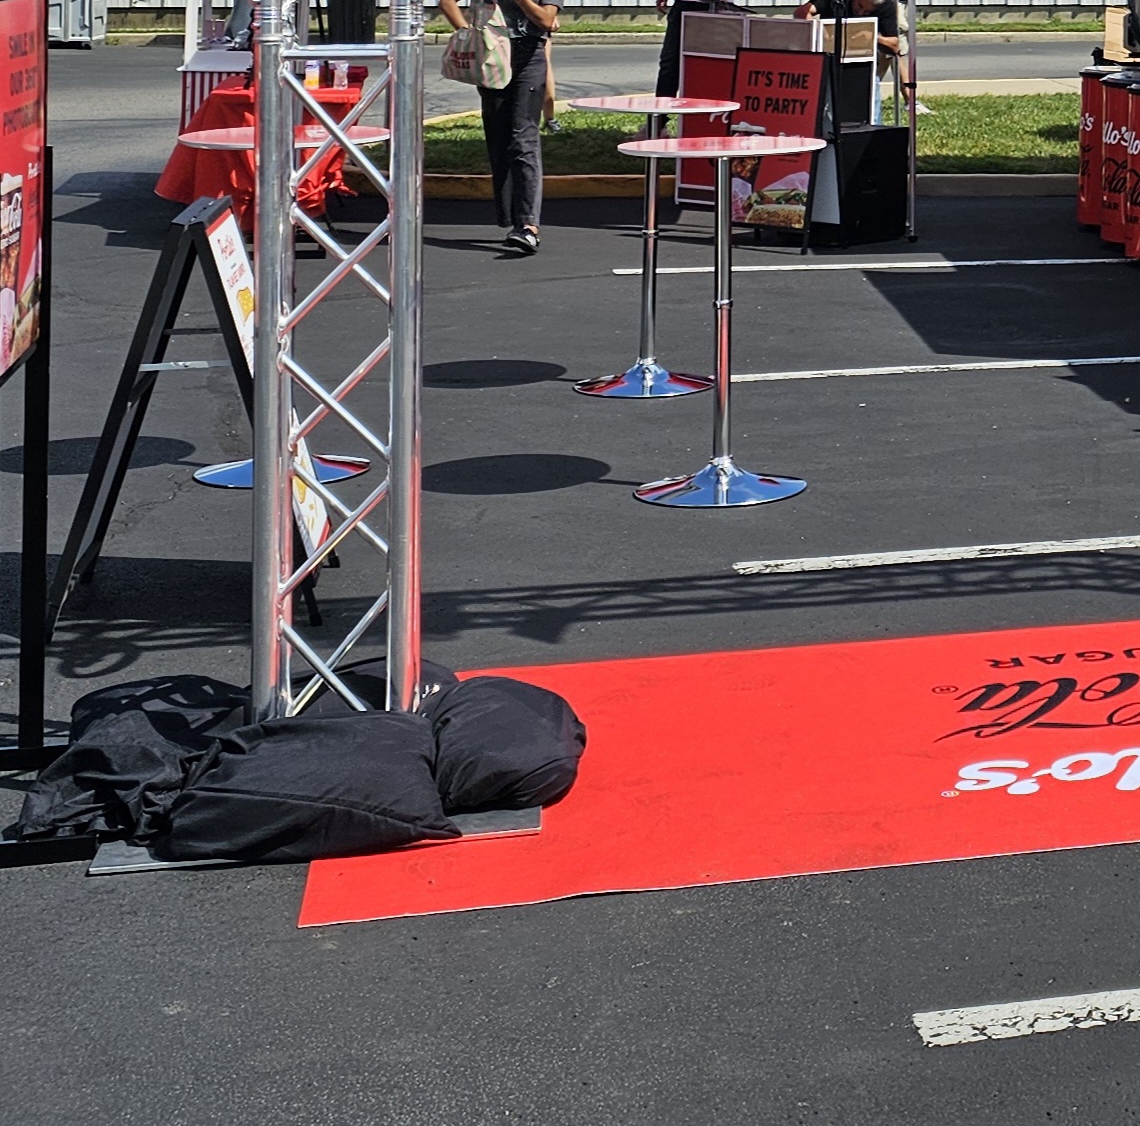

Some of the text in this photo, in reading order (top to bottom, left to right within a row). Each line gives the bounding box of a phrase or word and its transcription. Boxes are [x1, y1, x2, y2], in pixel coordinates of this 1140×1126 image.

[747, 70, 810, 90] IT'S TIME
[744, 96, 809, 115] TO PARTY
